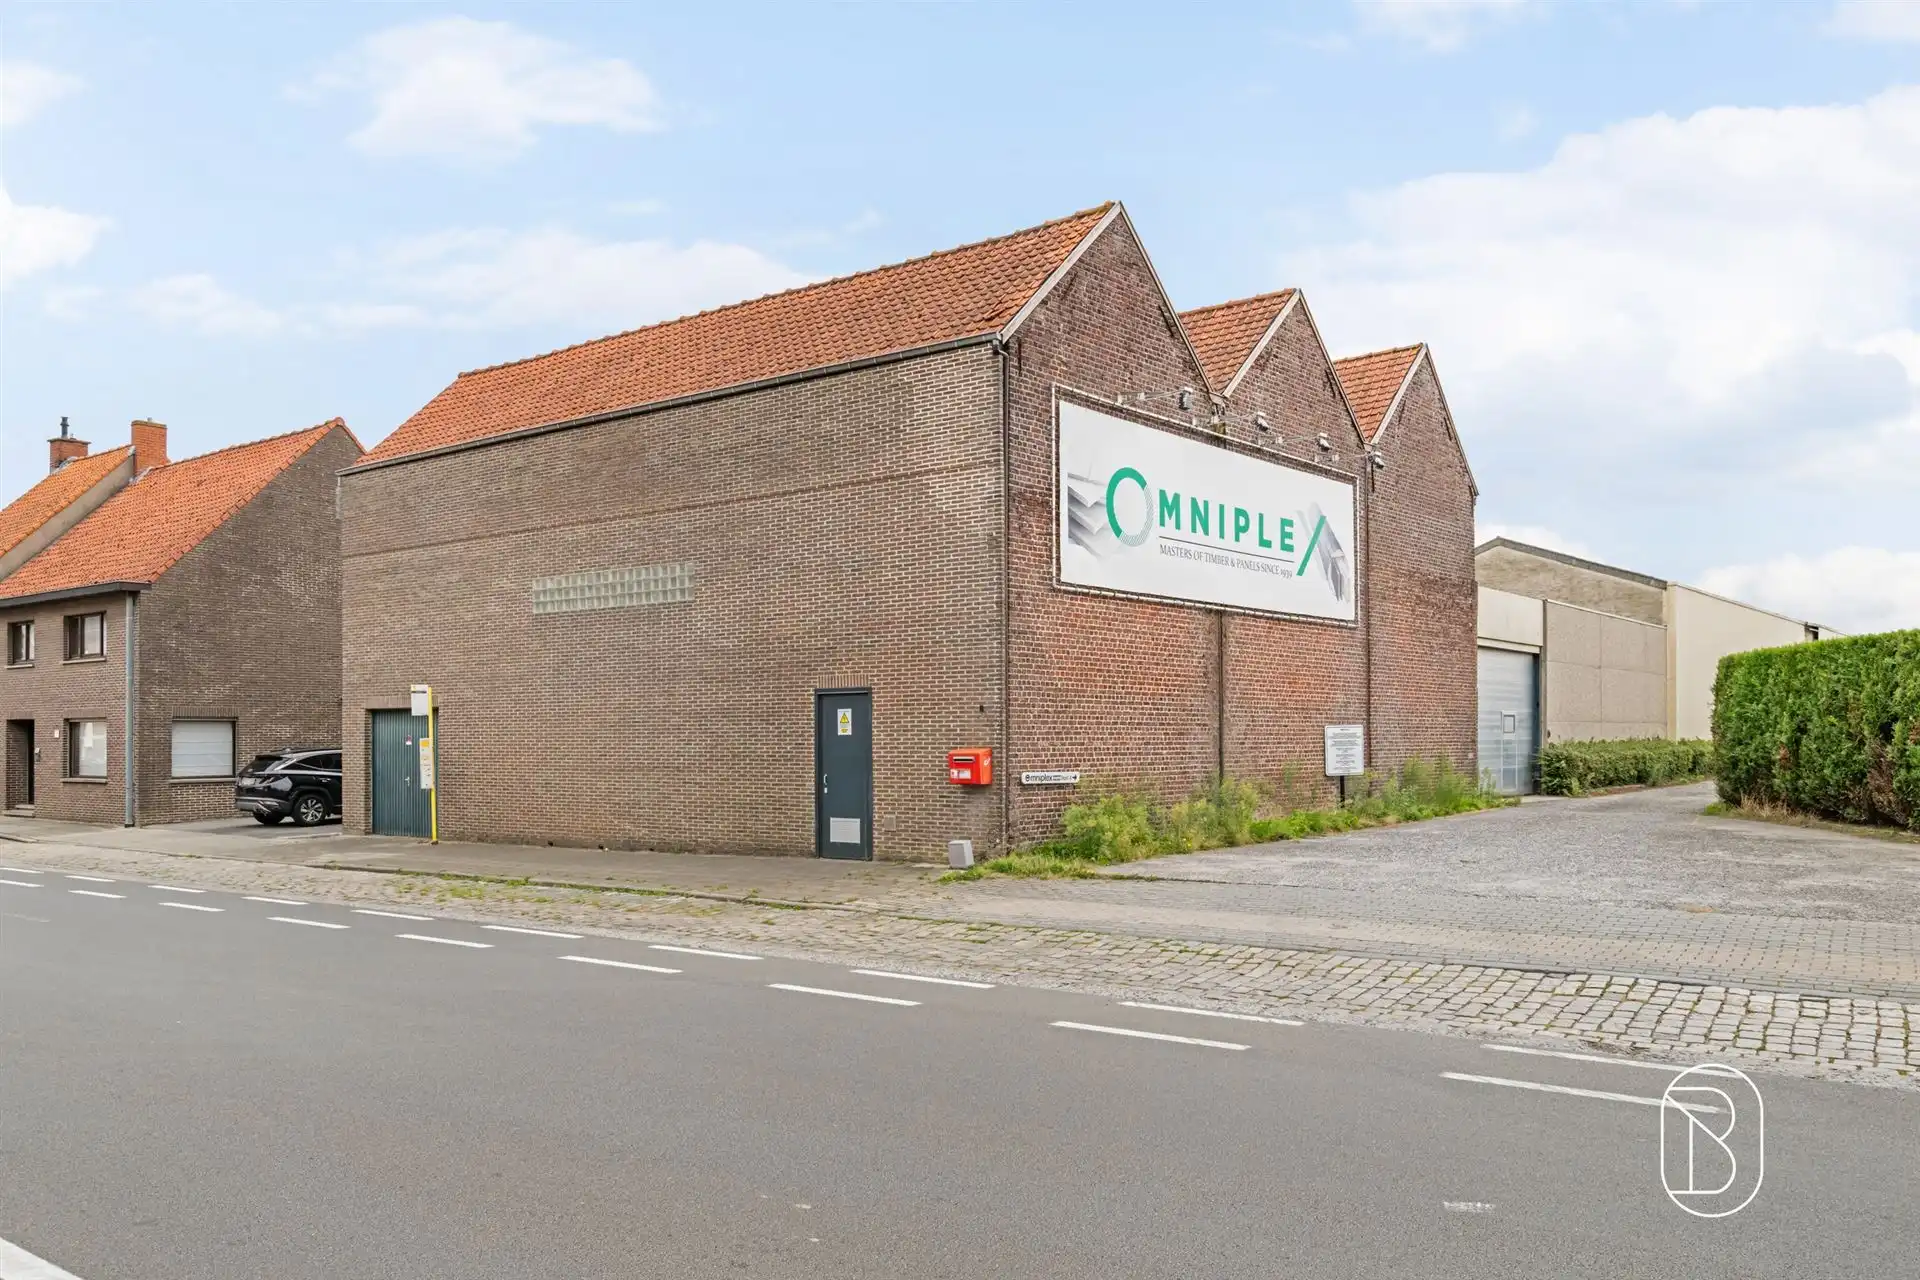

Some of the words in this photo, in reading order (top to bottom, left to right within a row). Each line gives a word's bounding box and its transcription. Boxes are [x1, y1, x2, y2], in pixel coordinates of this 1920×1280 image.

[1160, 544, 1192, 560] MASTERS
[1193, 551, 1203, 561] OF
[1204, 552, 1229, 566] TIMBER
[1237, 559, 1260, 571] PANELS
[1261, 563, 1280, 575] SINCE
